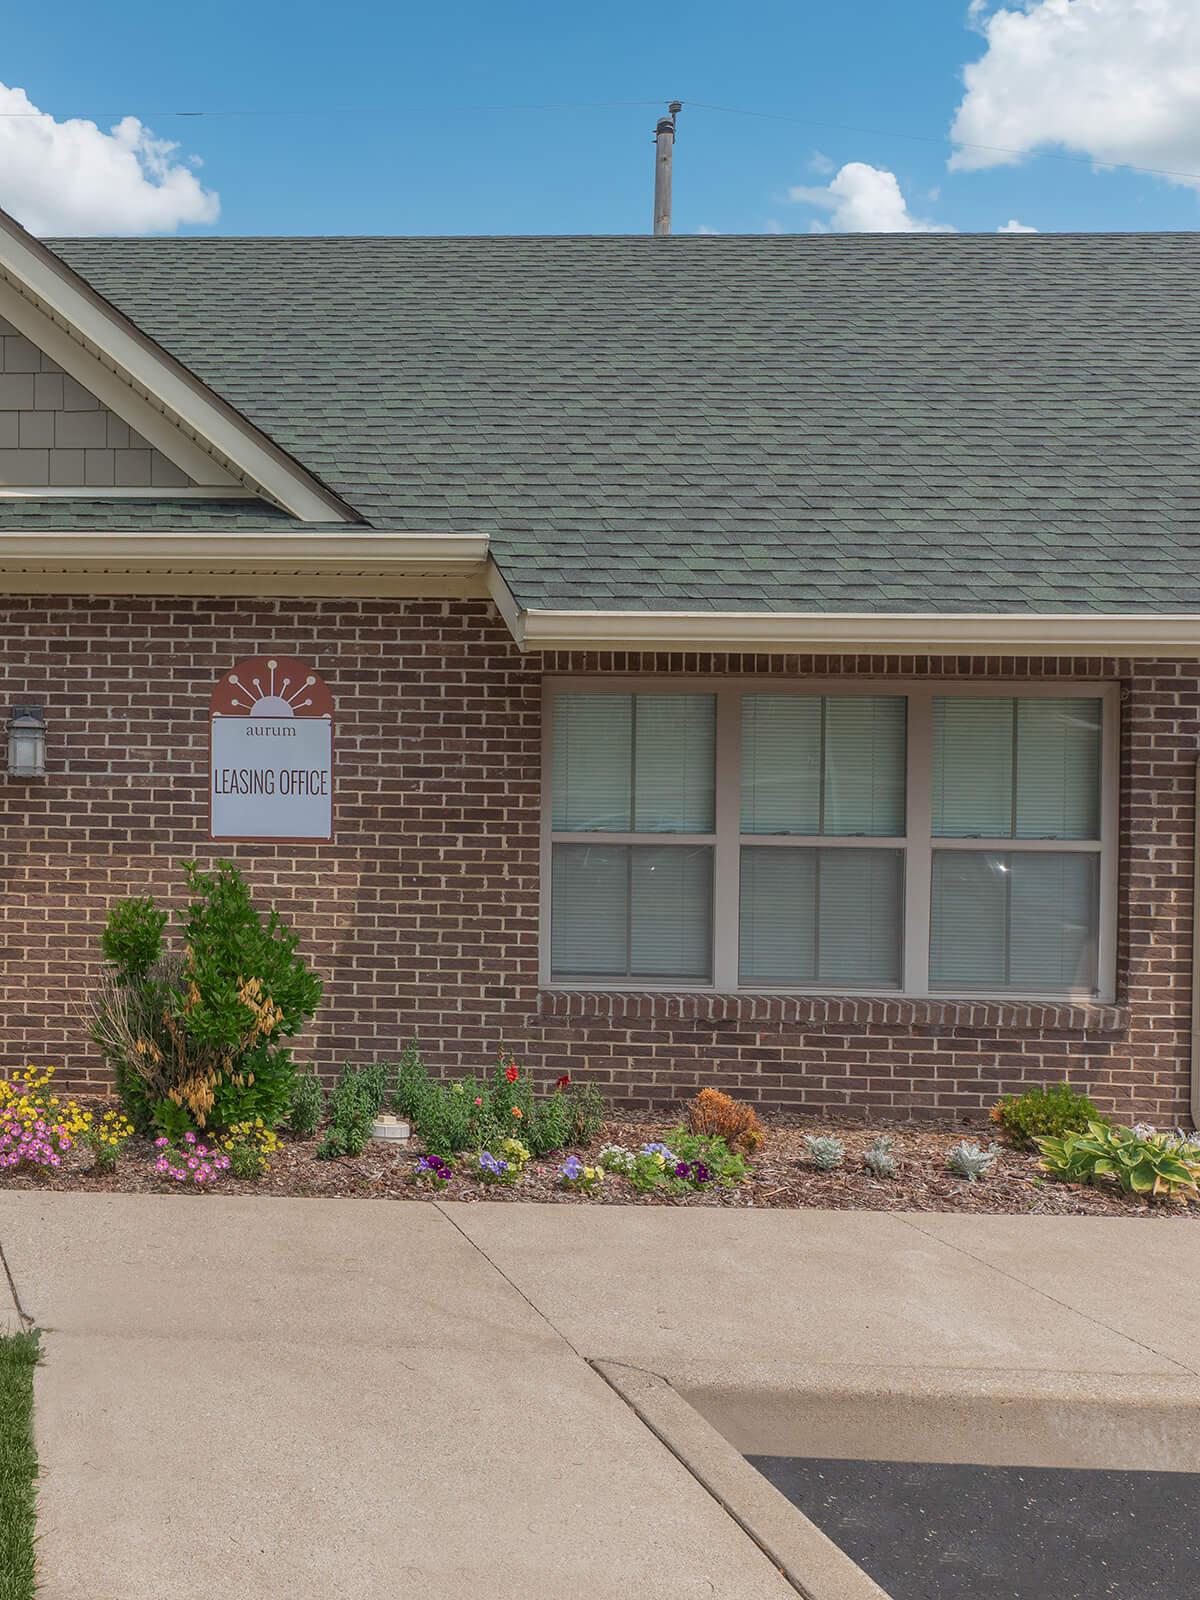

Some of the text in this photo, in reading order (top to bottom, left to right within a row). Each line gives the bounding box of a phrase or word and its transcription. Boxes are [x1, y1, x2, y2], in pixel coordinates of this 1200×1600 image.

[246, 726, 297, 737] aurum
[214, 769, 329, 796] LEASING OFFICE
